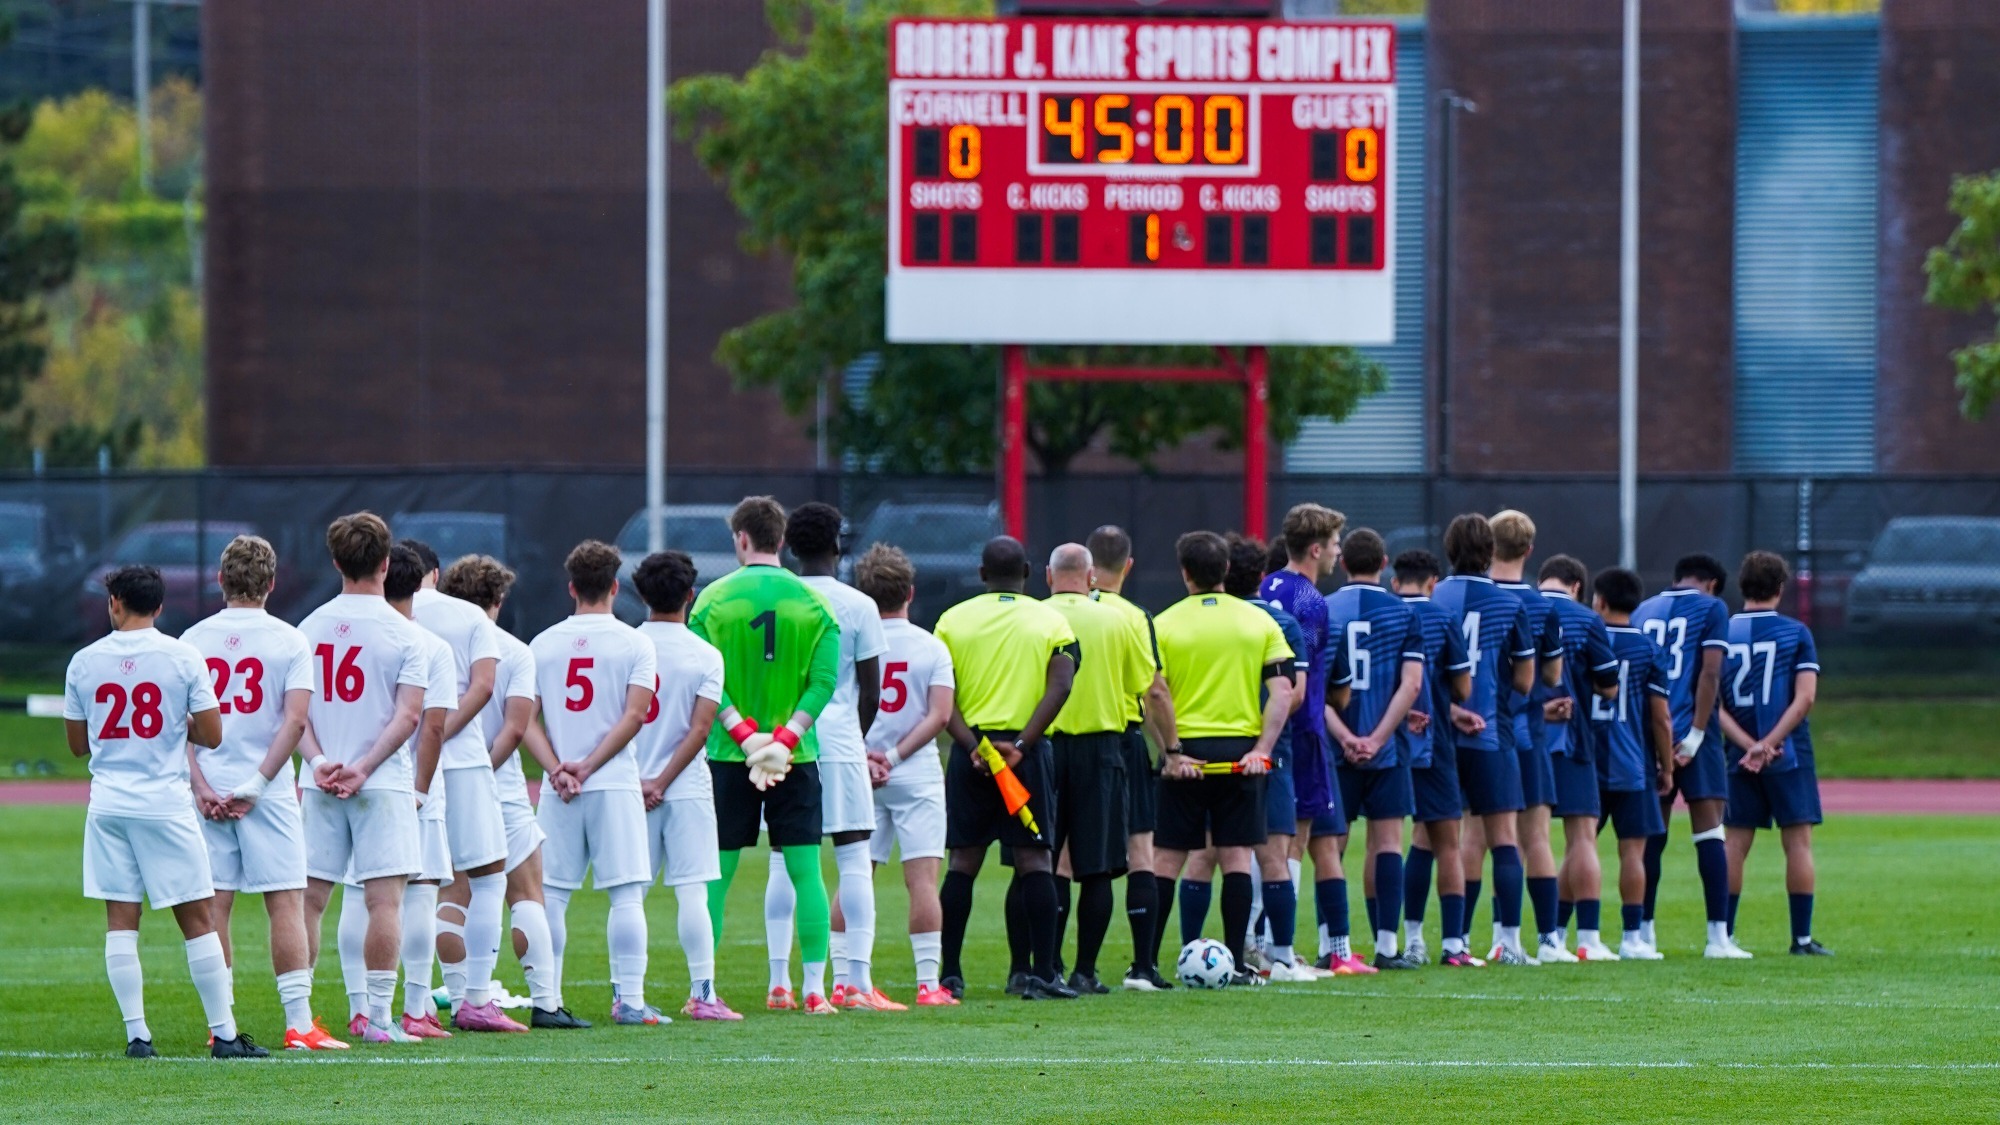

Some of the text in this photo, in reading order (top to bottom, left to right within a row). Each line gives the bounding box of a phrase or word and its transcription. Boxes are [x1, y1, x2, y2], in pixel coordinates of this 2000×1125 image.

[896, 22, 1391, 81] ROBERT J. KANE SPORTS COMPLEX
[898, 91, 1026, 126] CORNELL
[1044, 94, 1244, 165] 45:00
[1292, 94, 1387, 129] GUEST
[949, 124, 982, 179] 0
[1345, 127, 1378, 181] 0
[910, 181, 983, 210] SHOTS
[1104, 183, 1184, 211] PERIOD
[1304, 184, 1377, 212] SHOTS
[1146, 213, 1160, 261] 1
[749, 610, 776, 662] 1
[1347, 620, 1371, 690] 6
[206, 657, 263, 714] 23
[315, 643, 365, 702] 16
[565, 658, 594, 712] 5
[1727, 641, 1776, 707] 27
[95, 682, 163, 739] 28
